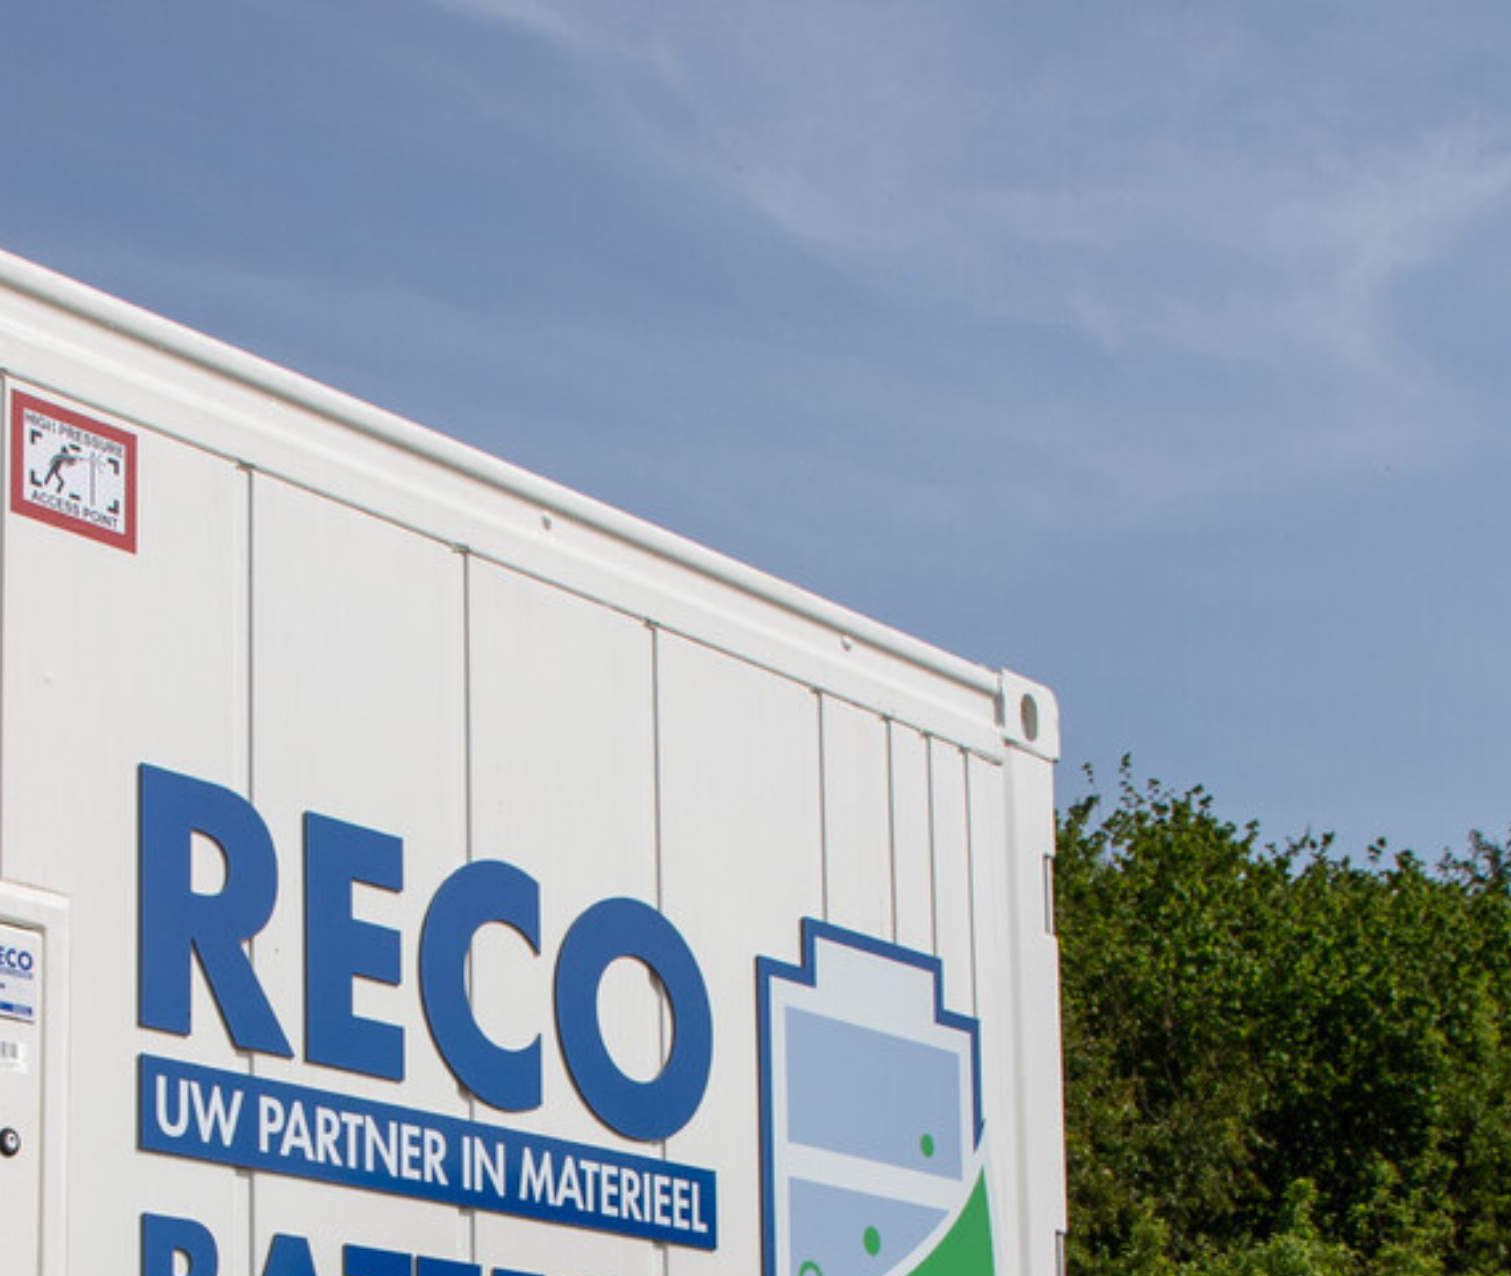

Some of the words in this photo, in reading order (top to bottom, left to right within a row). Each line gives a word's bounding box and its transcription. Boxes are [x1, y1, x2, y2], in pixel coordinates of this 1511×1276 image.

[25, 412, 56, 433] HIGH
[59, 421, 123, 457] PRESSURE
[31, 490, 80, 516] ACCESS
[83, 507, 118, 529] POINT
[138, 762, 713, 1143] RECO
[155, 1074, 244, 1147] UW
[258, 1095, 448, 1186] PARTNER
[462, 1135, 505, 1198] IN
[519, 1147, 708, 1233] MATERIEEL
